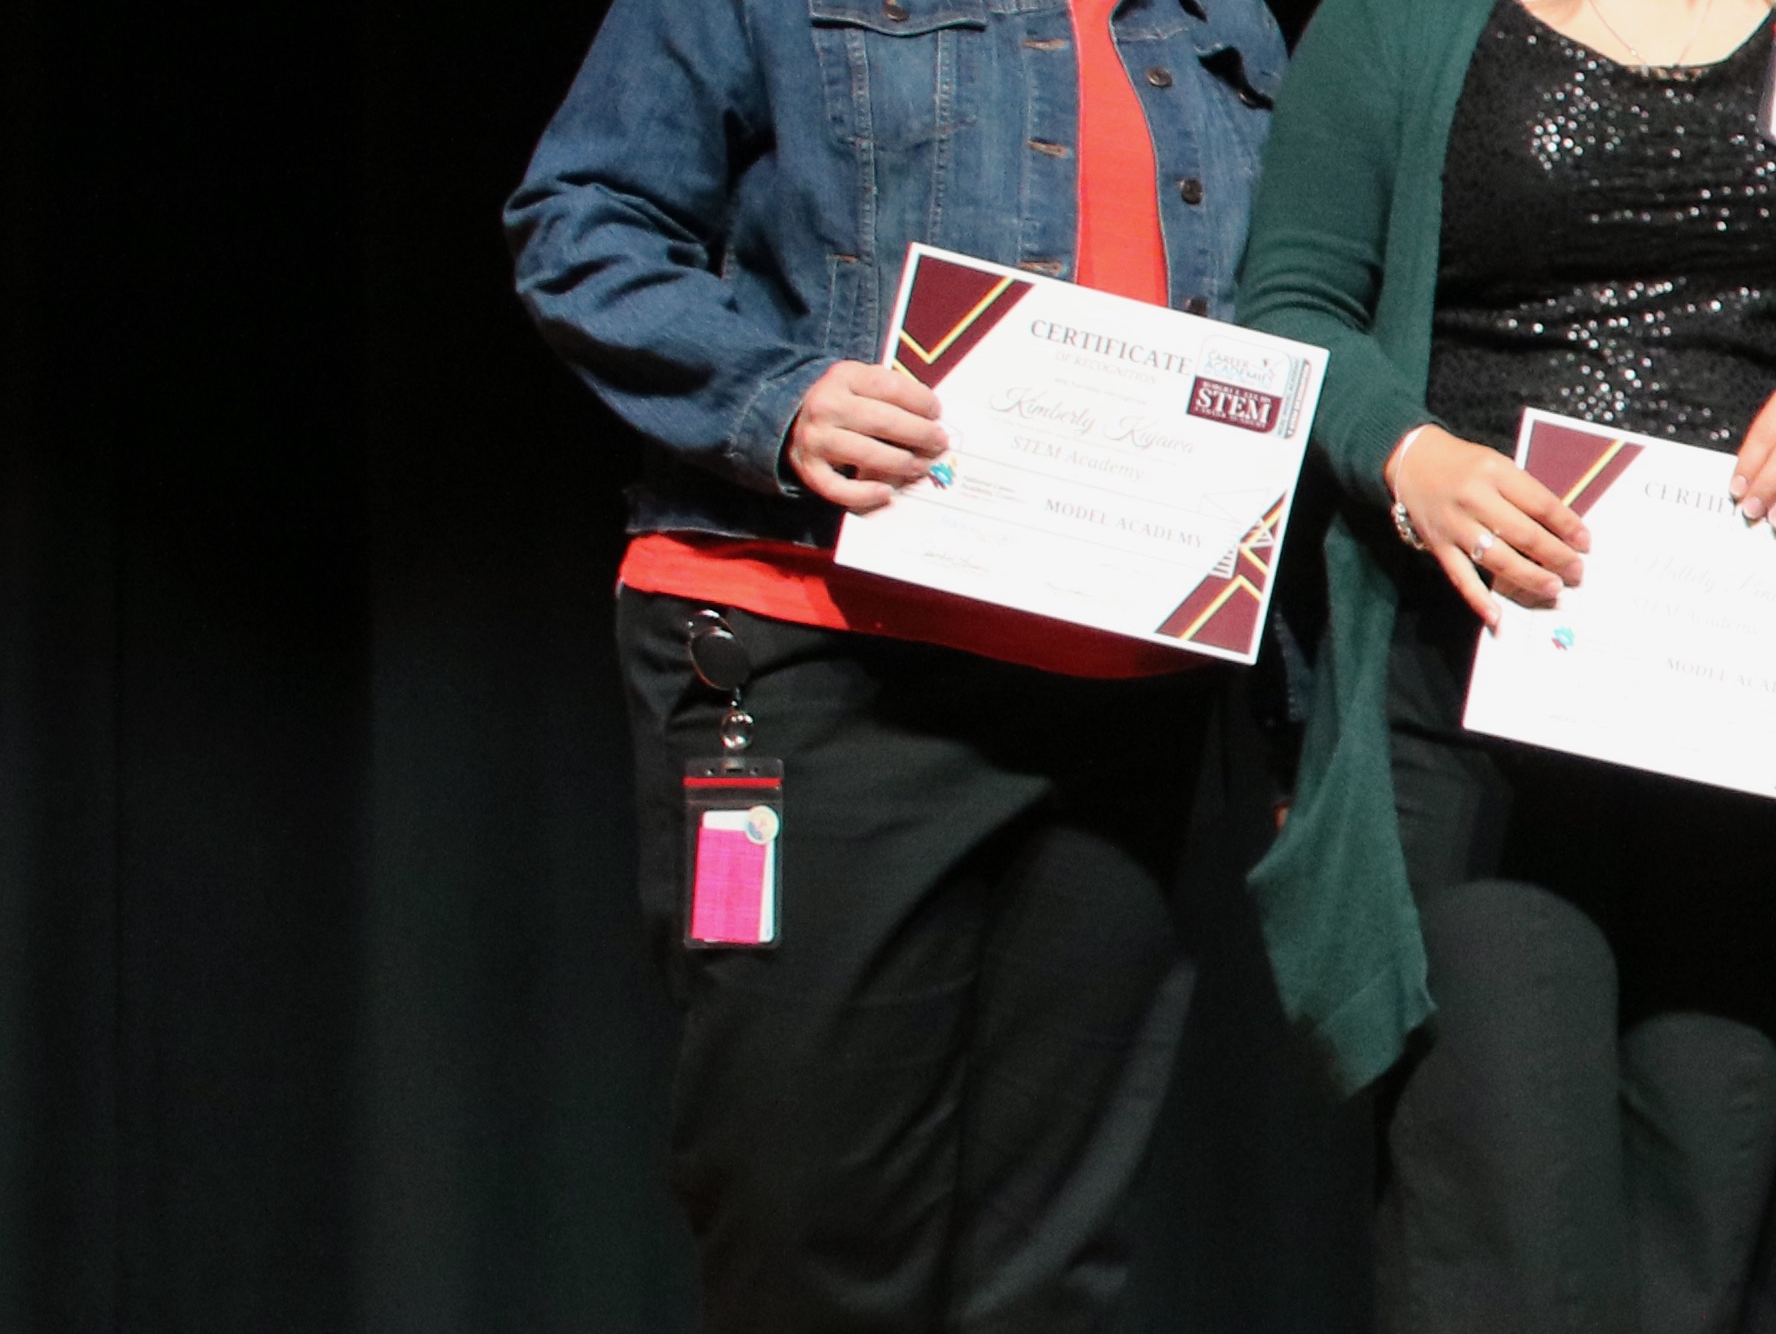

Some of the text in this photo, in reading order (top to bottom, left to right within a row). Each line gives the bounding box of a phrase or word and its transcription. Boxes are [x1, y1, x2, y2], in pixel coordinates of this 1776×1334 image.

[1029, 318, 1193, 376] CERTIFICATE
[1073, 355, 1157, 385] RECOGNITION
[989, 387, 1096, 436] Kimberly
[1195, 386, 1271, 426] STEM
[1010, 435, 1063, 460] STEM
[1064, 450, 1145, 482] Academy
[1044, 498, 1202, 549] MODEL ACADEMY
[1667, 657, 1725, 682] MODEL
